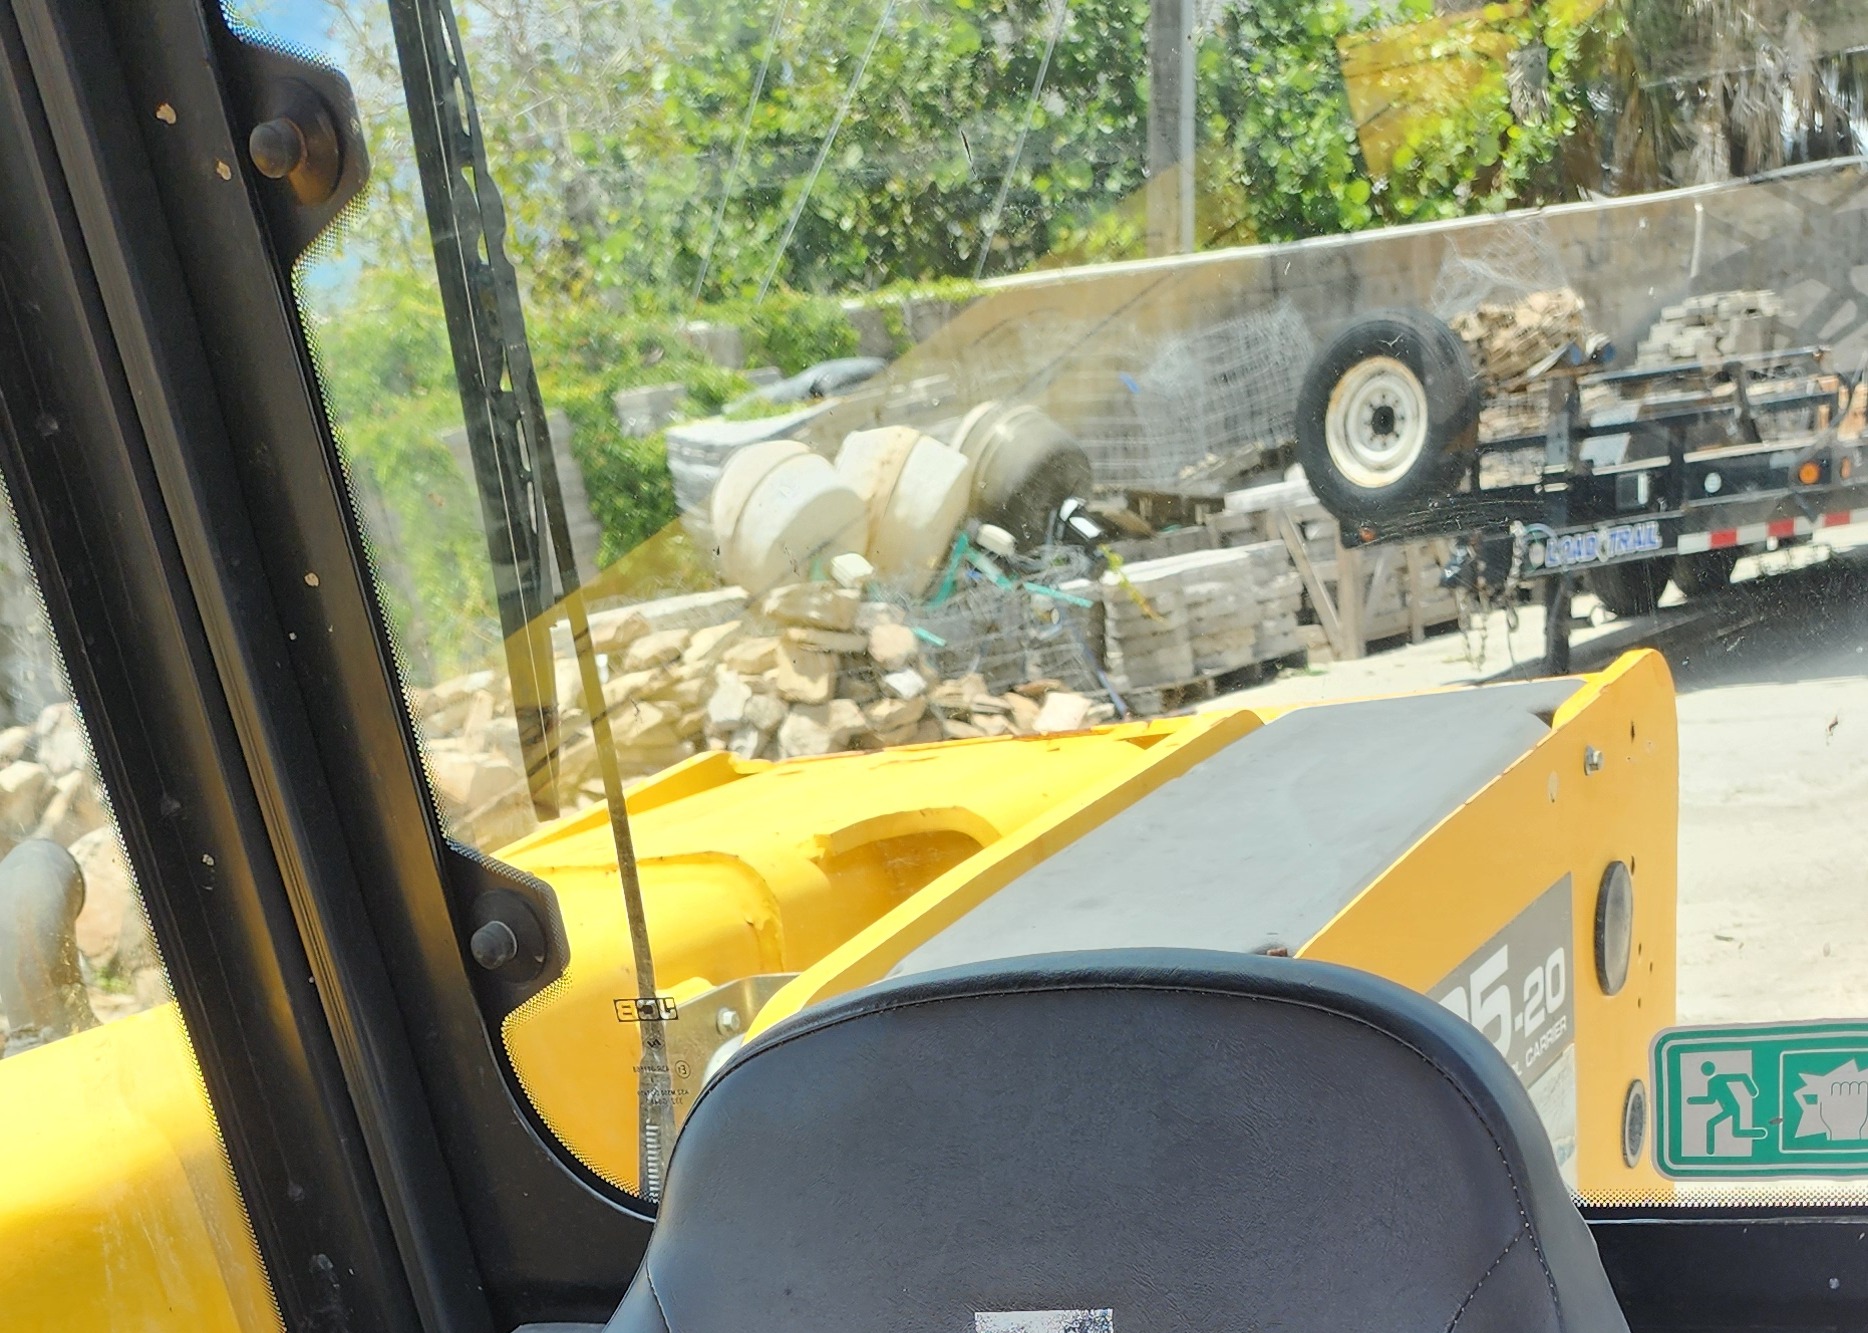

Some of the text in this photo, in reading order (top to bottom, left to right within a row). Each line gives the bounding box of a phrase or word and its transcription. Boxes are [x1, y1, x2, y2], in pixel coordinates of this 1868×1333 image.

[1608, 520, 1663, 558] TRAIL
[1438, 944, 1566, 1058] 5-20
[1525, 1015, 1567, 1068] CARRIER
